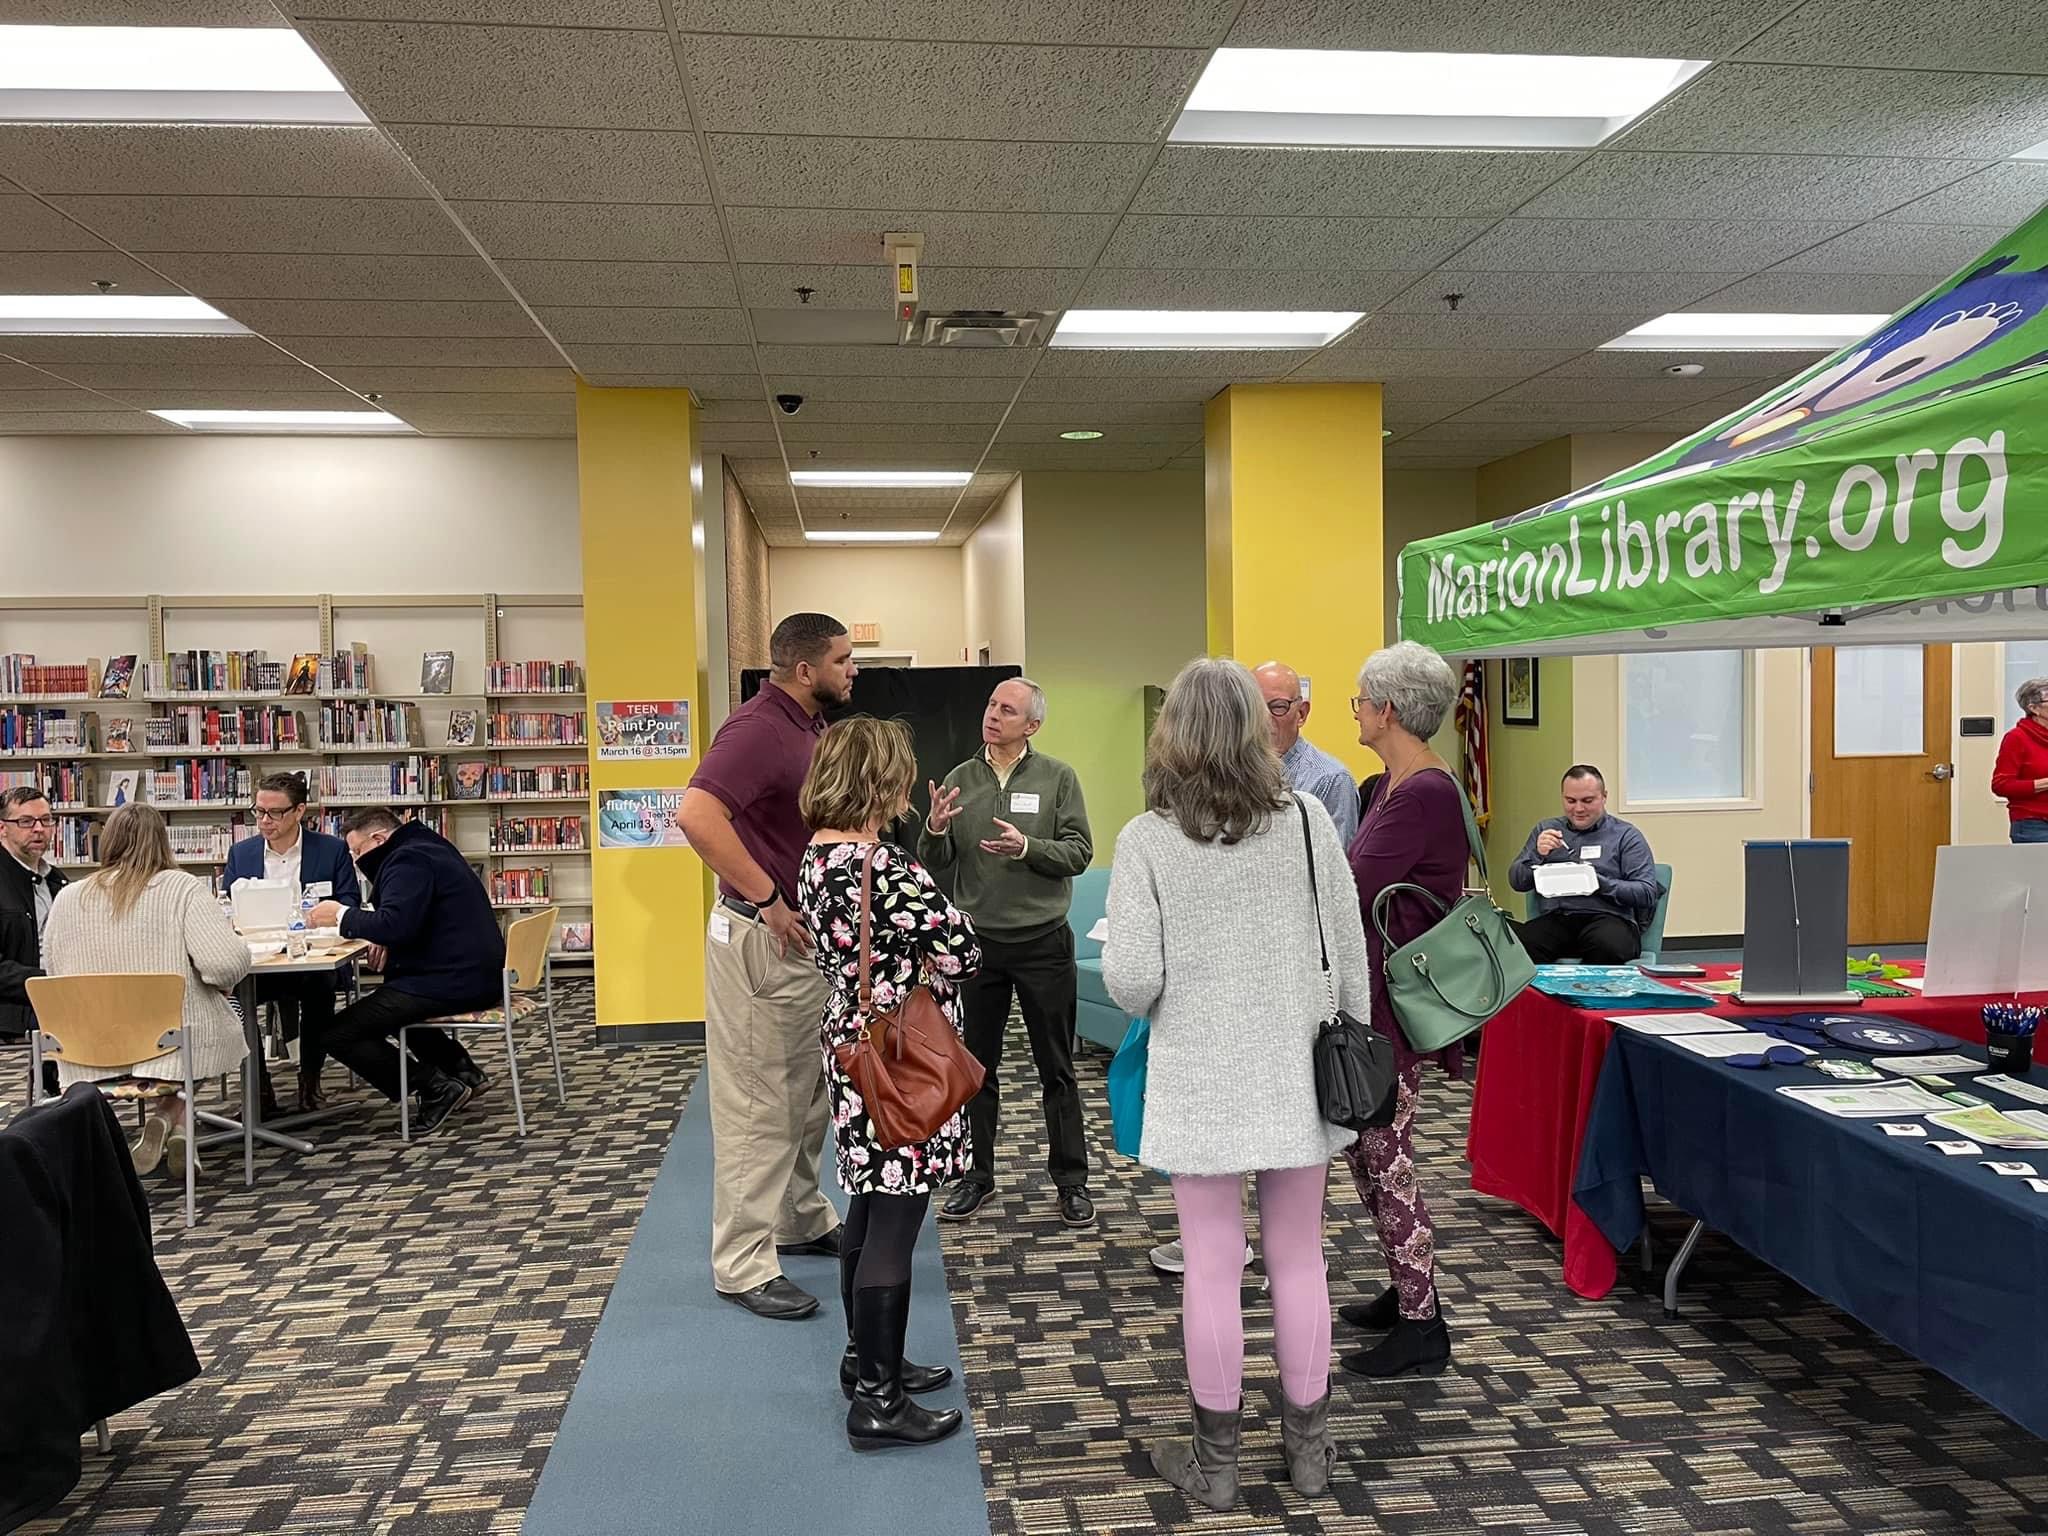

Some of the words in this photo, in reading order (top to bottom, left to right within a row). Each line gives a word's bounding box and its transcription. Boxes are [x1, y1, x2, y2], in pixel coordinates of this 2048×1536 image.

[1426, 429, 2008, 625] MarionLibrary.org
[854, 623, 876, 641] EXIT
[626, 704, 658, 715] TEEN
[607, 720, 643, 732] Paint
[646, 719, 681, 732] Pour
[633, 730, 658, 745] Art
[600, 747, 629, 757] March
[631, 747, 642, 756] 16
[642, 746, 654, 758] @
[654, 746, 688, 757] 3:15pm
[611, 819, 636, 832] April
[639, 819, 652, 830] 13
